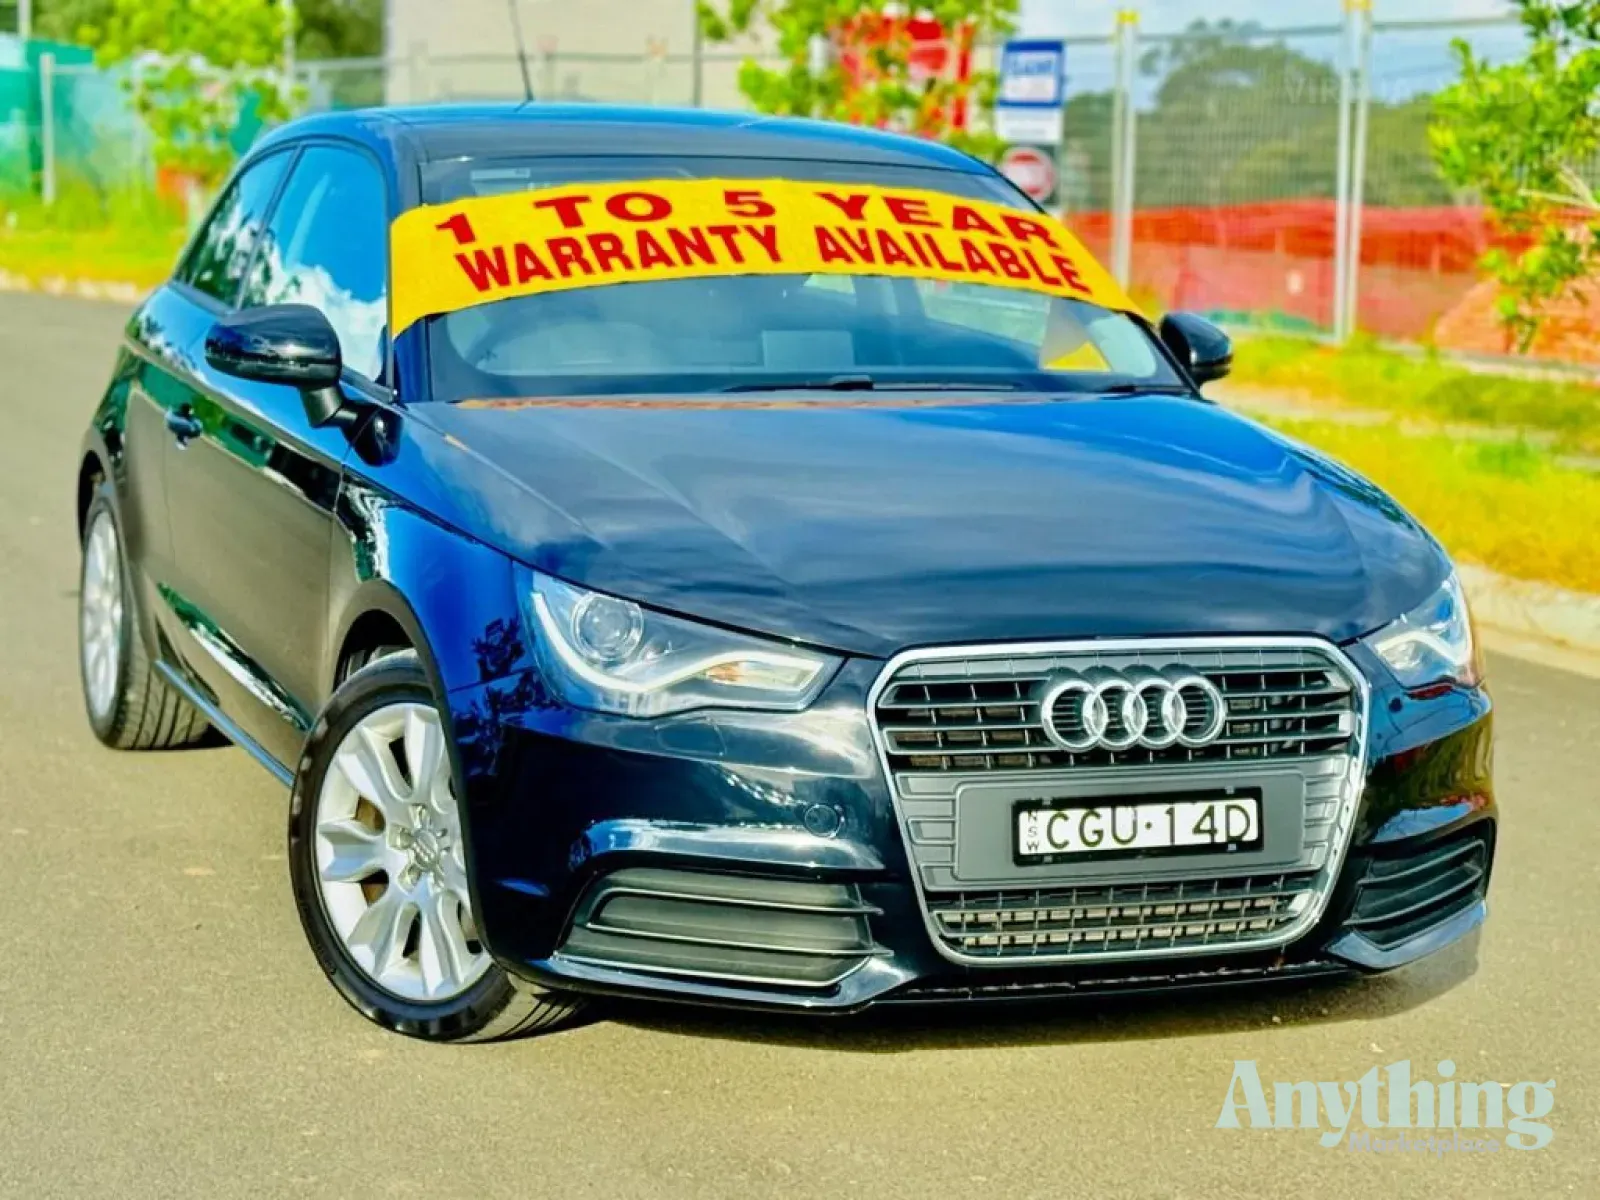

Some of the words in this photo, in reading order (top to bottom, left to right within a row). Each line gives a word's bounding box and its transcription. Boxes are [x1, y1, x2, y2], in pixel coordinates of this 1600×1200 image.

[435, 213, 476, 245] 1
[533, 191, 674, 229] TO
[723, 190, 776, 218] 5
[818, 192, 1063, 250] YEAR
[455, 224, 783, 292] WARRANTY
[814, 226, 1093, 293] AVAILABLE
